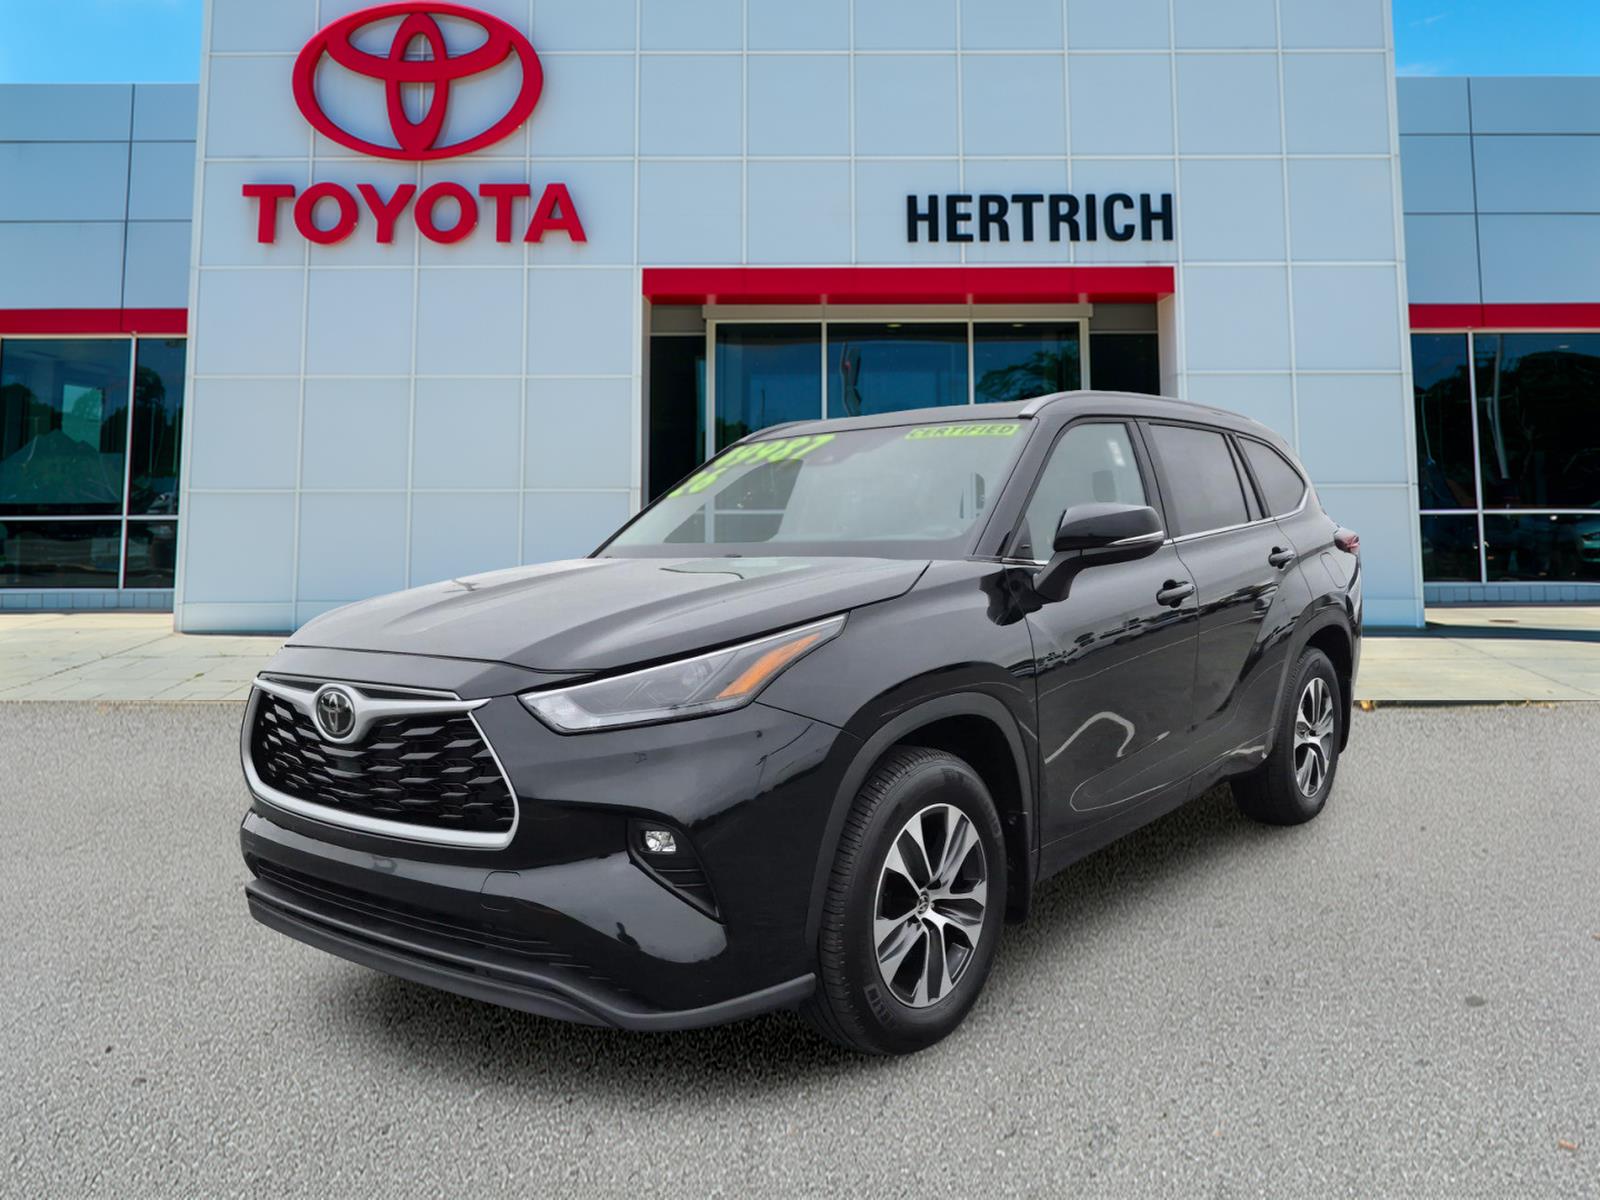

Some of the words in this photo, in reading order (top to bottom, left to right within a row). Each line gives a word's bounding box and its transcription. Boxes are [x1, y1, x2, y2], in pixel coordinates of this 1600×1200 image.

[242, 182, 588, 244] TOYOTA
[906, 193, 1173, 242] HERTRICH
[907, 424, 1018, 438] CERTIFIED
